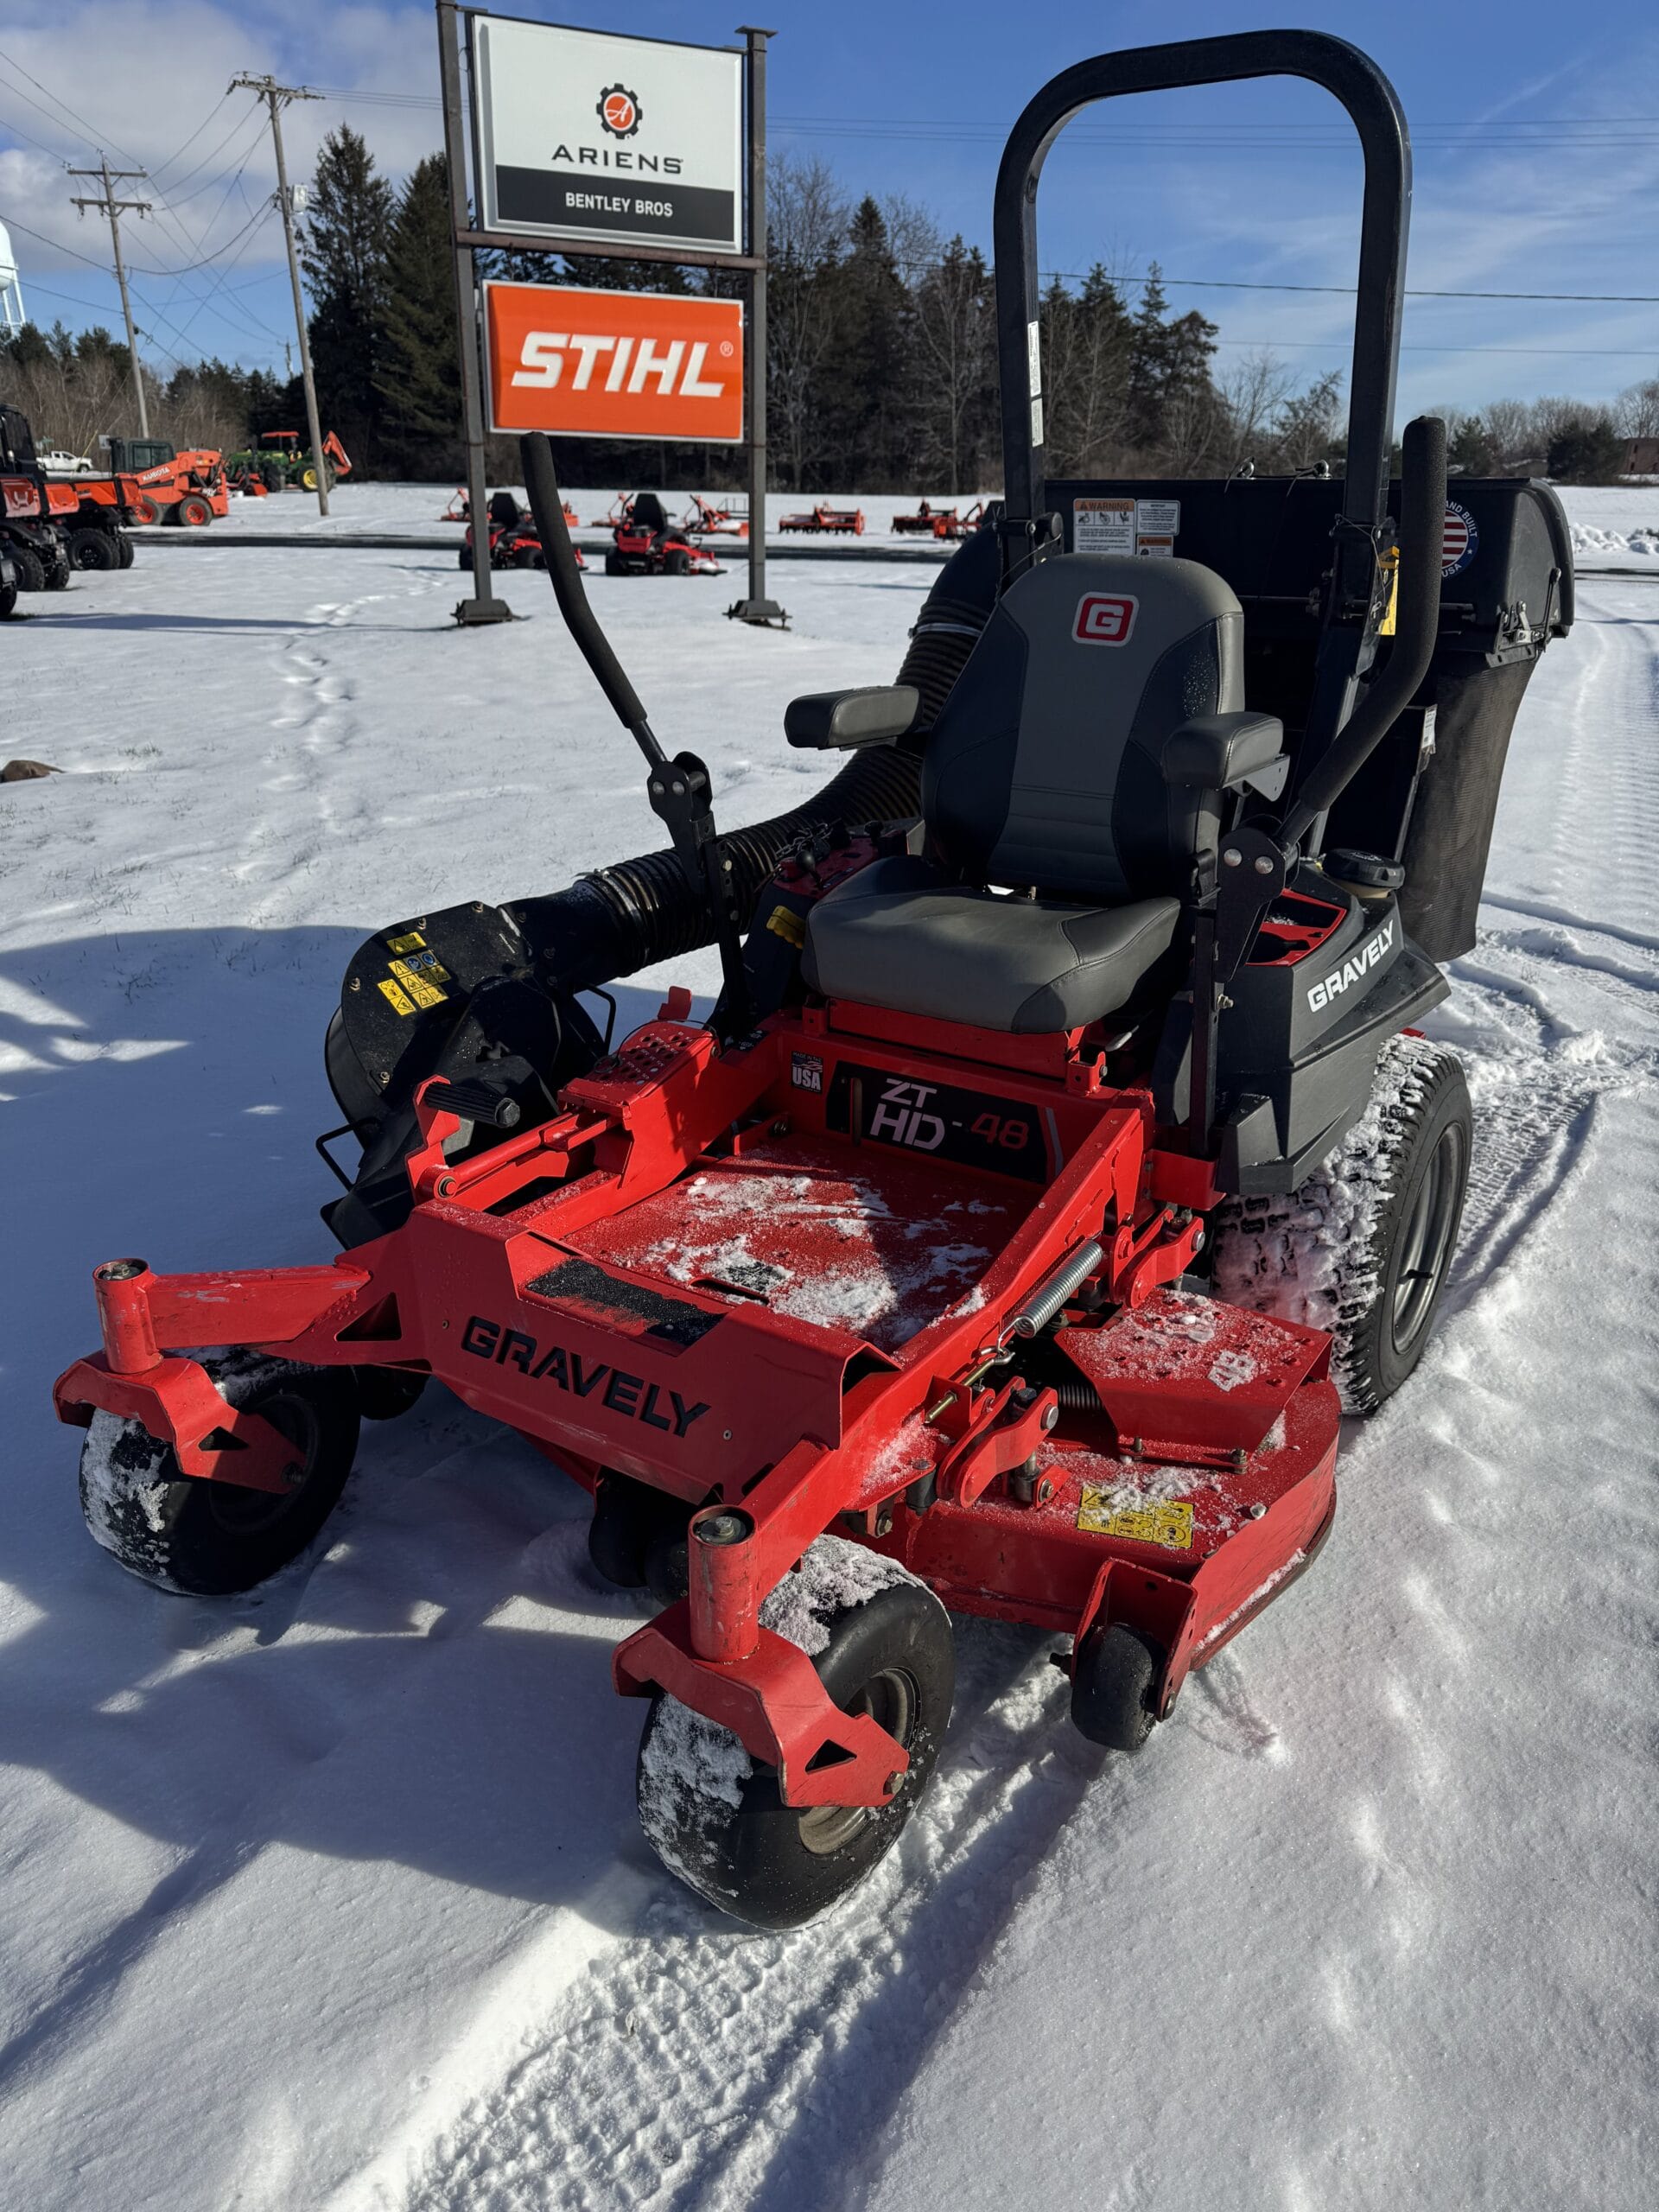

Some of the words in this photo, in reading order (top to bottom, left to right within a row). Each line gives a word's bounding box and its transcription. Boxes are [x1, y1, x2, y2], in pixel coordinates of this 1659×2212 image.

[551, 144, 682, 174] ARIENS
[565, 192, 631, 213] BENTLEY
[634, 200, 673, 218] BROS
[511, 331, 726, 397] STIHL
[1089, 502, 1129, 511] WARNING
[1461, 511, 1478, 538] BUILT
[1441, 563, 1463, 578] USA
[1306, 918, 1395, 1013] GRAVELY
[792, 1066, 822, 1090] USA
[881, 1077, 938, 1108] ZT
[869, 1103, 946, 1151] HD
[461, 1316, 711, 1437] GRAVELY
